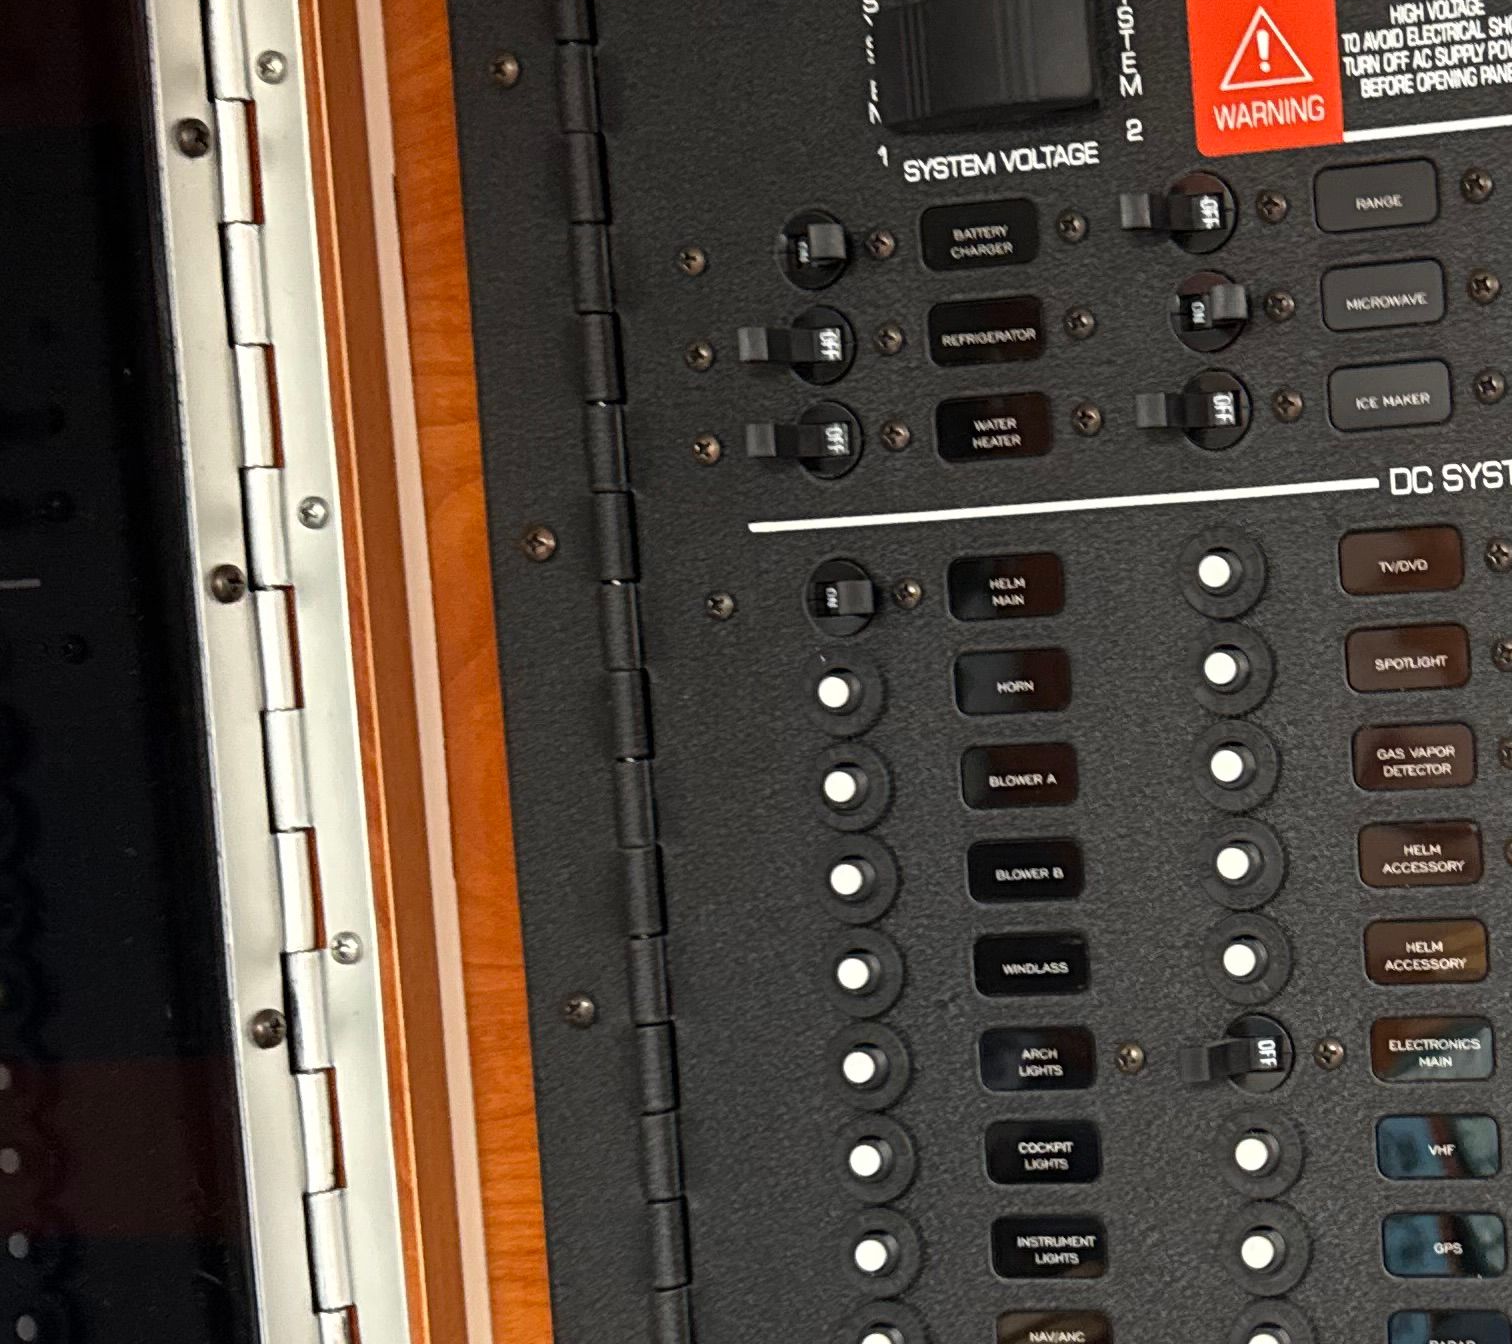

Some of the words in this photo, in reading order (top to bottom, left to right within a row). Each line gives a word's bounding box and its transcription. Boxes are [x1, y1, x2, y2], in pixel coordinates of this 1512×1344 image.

[1389, 3, 1425, 25] HIGH
[1341, 32, 1360, 53] TO
[1362, 26, 1405, 51] AVOID
[1407, 19, 1485, 47] ELECTRICAL
[1343, 55, 1380, 76] TURN
[1384, 52, 1409, 72] OFF
[1411, 49, 1432, 69] AC
[1434, 41, 1485, 67] SUPPLY
[1360, 73, 1414, 98] BEFORE
[1418, 67, 1477, 93] OPENING
[1212, 94, 1325, 132] WARNING
[903, 147, 997, 183] SYSTEM
[1000, 141, 1100, 173] VOLTAGE
[1355, 195, 1403, 211] RANGE
[1346, 293, 1428, 310] MICROWAVE
[941, 328, 1037, 347] REFRIGERATOR
[973, 418, 1017, 433] WATER
[1389, 466, 1433, 496] DC
[1375, 655, 1448, 671] SPOTLIGHT
[996, 680, 1034, 693] HORN
[1383, 764, 1451, 777] DETECTOR
[1382, 861, 1465, 874] ACCESSORY
[1002, 962, 1069, 976] WINDLASS
[1385, 959, 1467, 971] ACCESSORY
[1389, 1039, 1481, 1051] ELECTRONICS
[1017, 1236, 1096, 1248] INSTRUMENT
